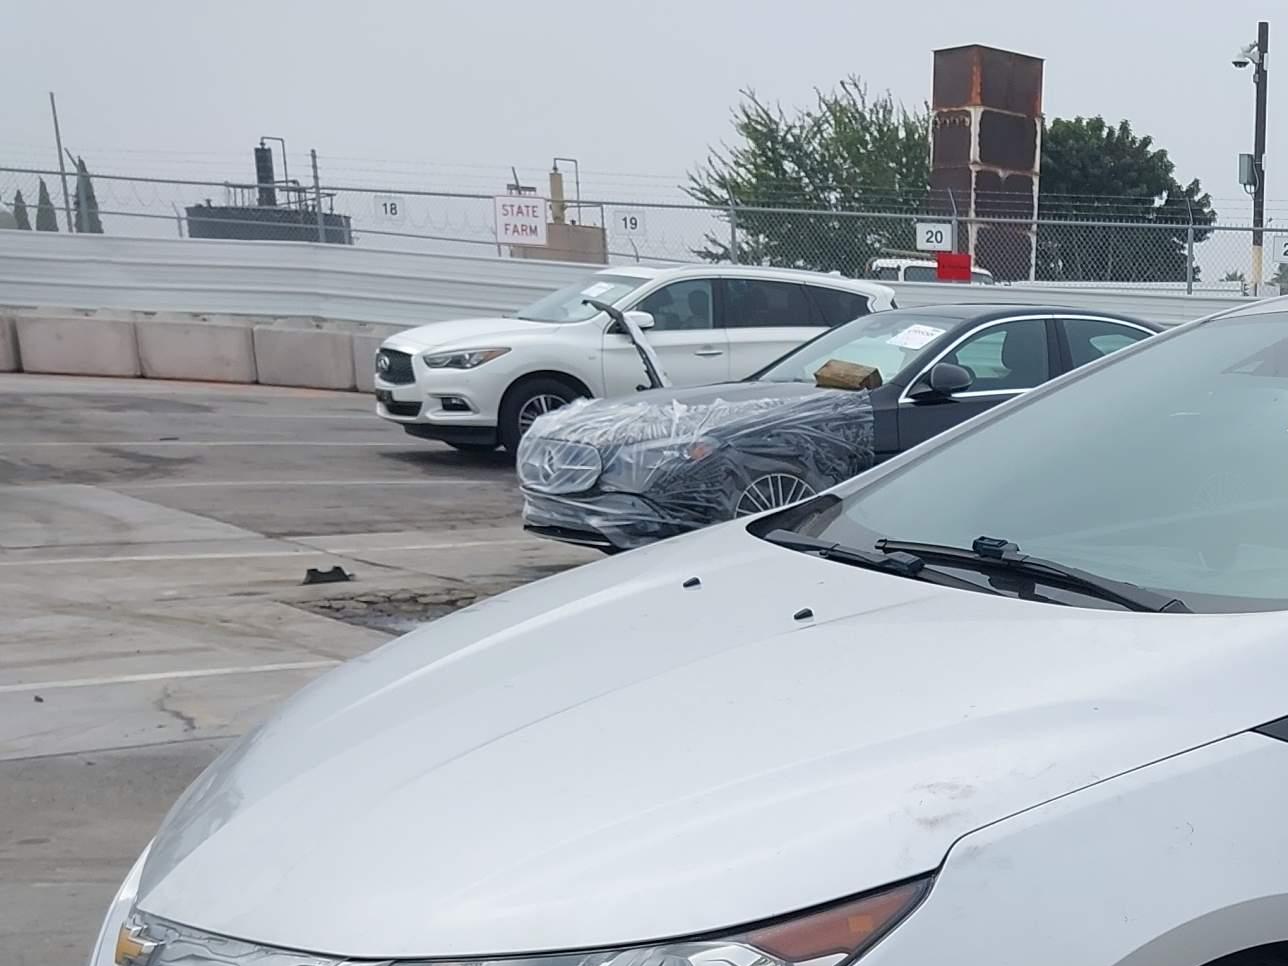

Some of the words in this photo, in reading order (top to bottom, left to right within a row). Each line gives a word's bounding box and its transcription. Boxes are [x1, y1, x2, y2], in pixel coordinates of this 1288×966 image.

[382, 202, 398, 216] 18
[502, 204, 539, 218] STATE
[504, 223, 538, 237] FARM
[622, 216, 638, 230] 19
[925, 229, 944, 244] 20
